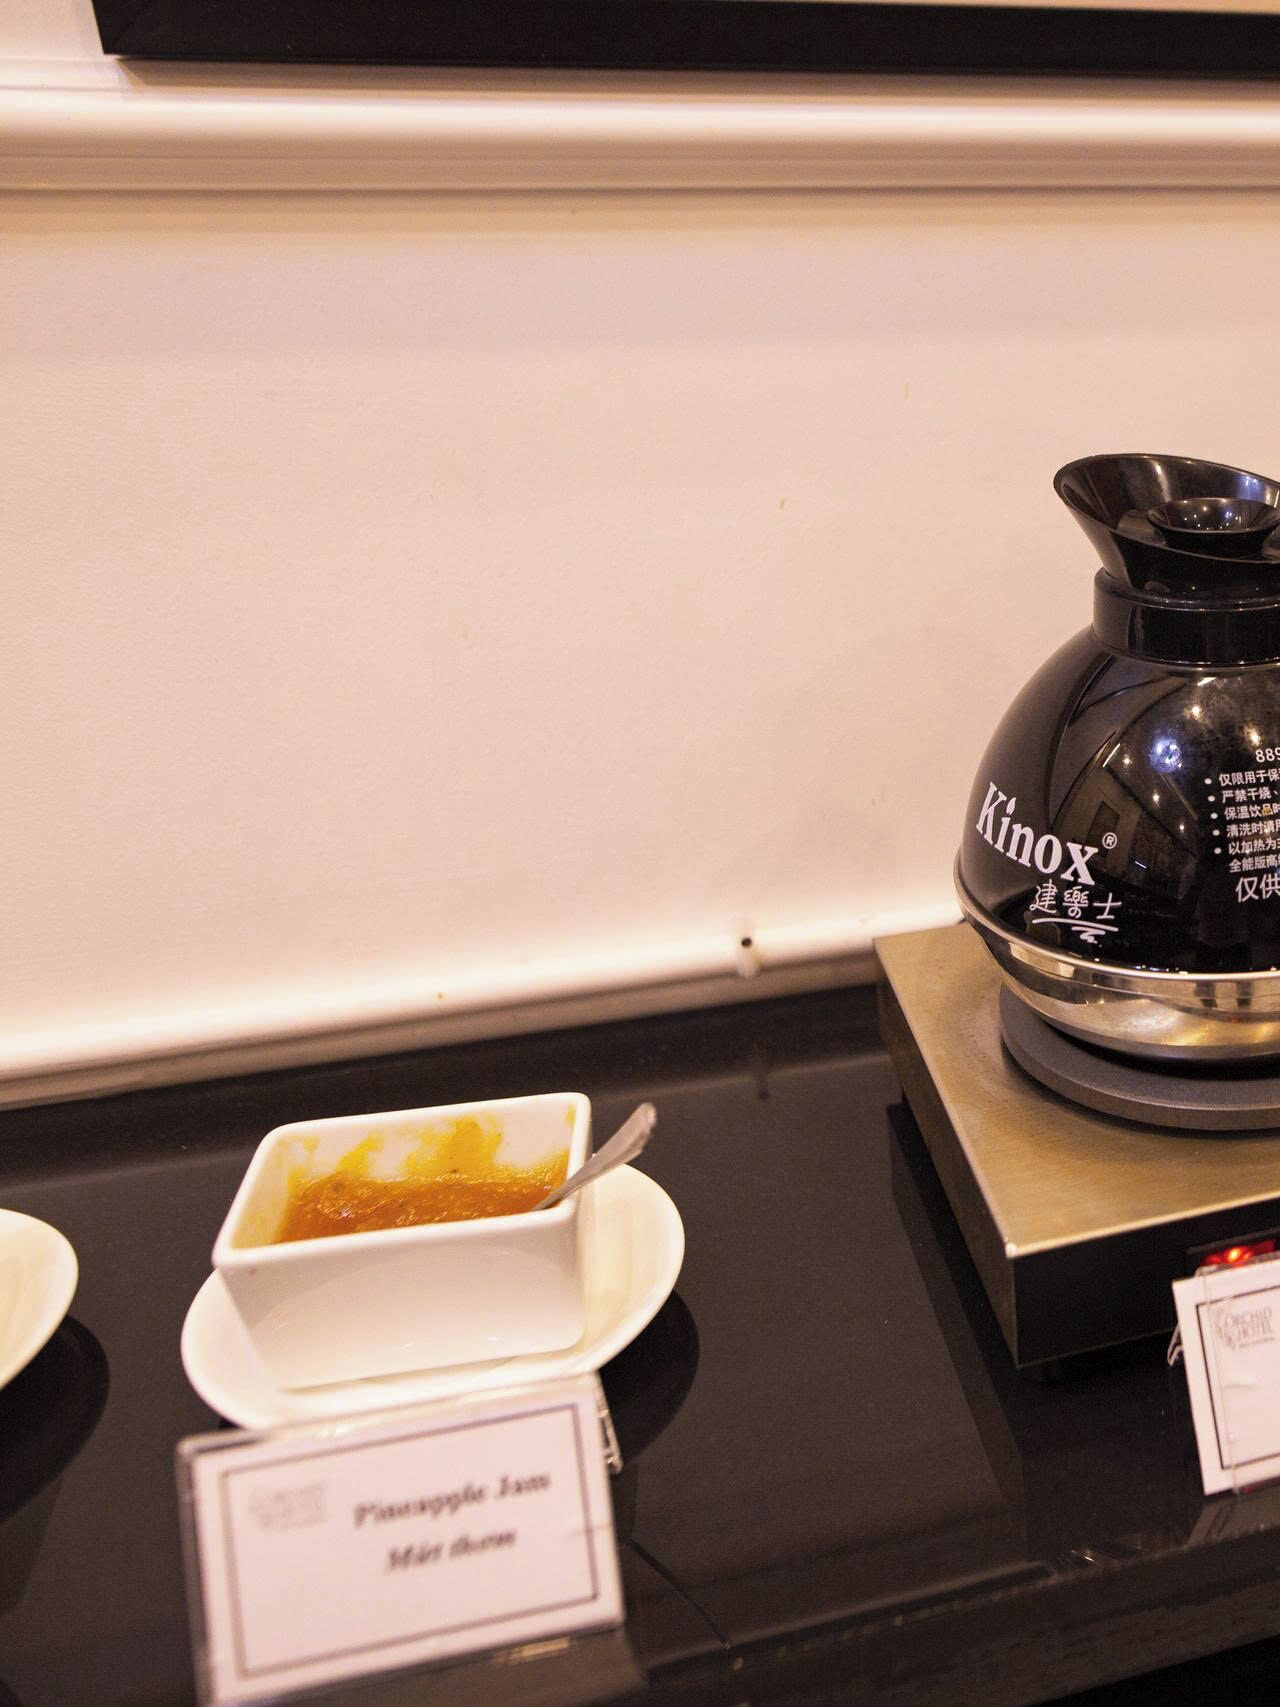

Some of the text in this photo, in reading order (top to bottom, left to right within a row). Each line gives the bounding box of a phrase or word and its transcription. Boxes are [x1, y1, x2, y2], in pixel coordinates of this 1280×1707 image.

[976, 781, 1099, 886] Kinox
[354, 1483, 485, 1527] Pineapple
[496, 1473, 551, 1499] Jam
